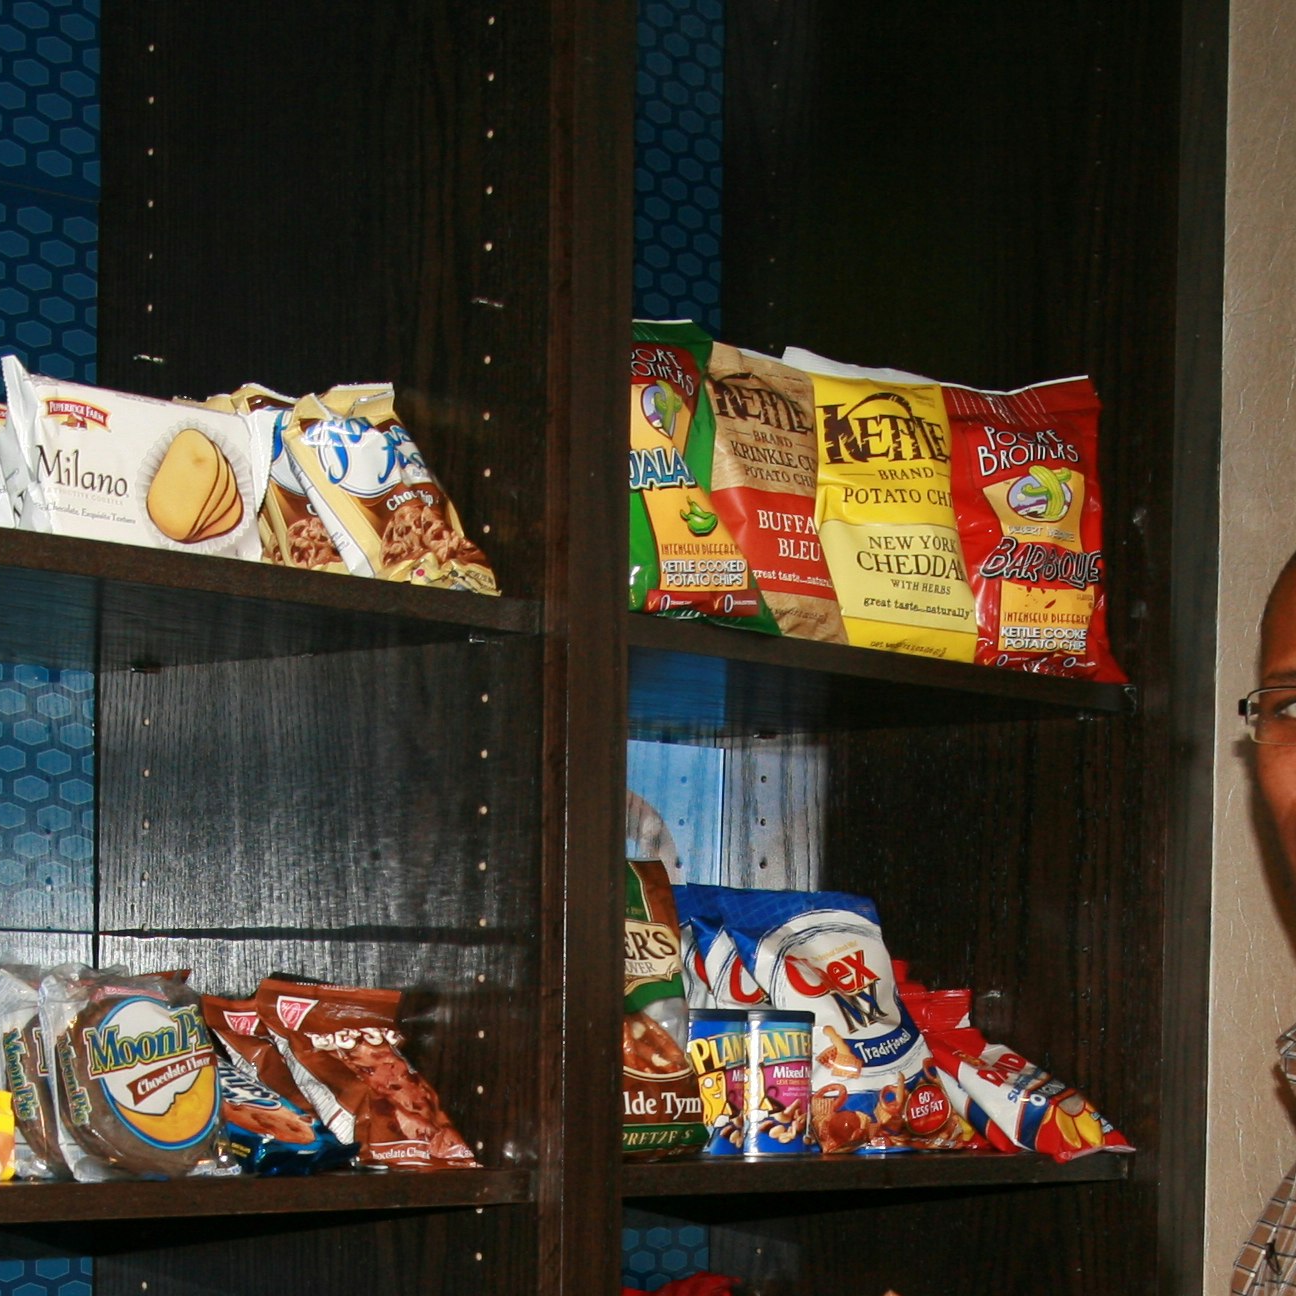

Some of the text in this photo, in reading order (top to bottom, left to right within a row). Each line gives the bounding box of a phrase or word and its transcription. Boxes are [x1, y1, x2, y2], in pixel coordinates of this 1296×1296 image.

[49, 401, 105, 423] PEPPERIDGE FARM
[816, 392, 950, 465] KETTLE
[753, 430, 794, 449] BRAND
[983, 426, 1064, 451] POORE
[730, 440, 799, 470] KRINKLE
[977, 443, 1080, 477] BROTHERS
[36, 445, 128, 497] Milano
[745, 465, 790, 483] POTATO
[878, 467, 934, 481] BRAND
[843, 487, 922, 504] POTATO
[757, 509, 819, 535] BUFFA
[777, 537, 821, 562] BLEU
[868, 536, 958, 553] NEW YORK
[661, 560, 746, 573] KETTLE COOKED
[666, 573, 744, 587] POTATO CHIPS
[891, 579, 951, 595] WITH HERBS
[863, 597, 892, 610] great
[1004, 611, 1048, 623] INTENSELY
[1000, 627, 1087, 641] KETTLE COOKE
[1004, 638, 1057, 651] POTATO
[853, 1028, 912, 1064] Traditional
[136, 1064, 186, 1096] Chocolate
[772, 1065, 803, 1081] Mixed
[910, 1104, 929, 1119] LESS
